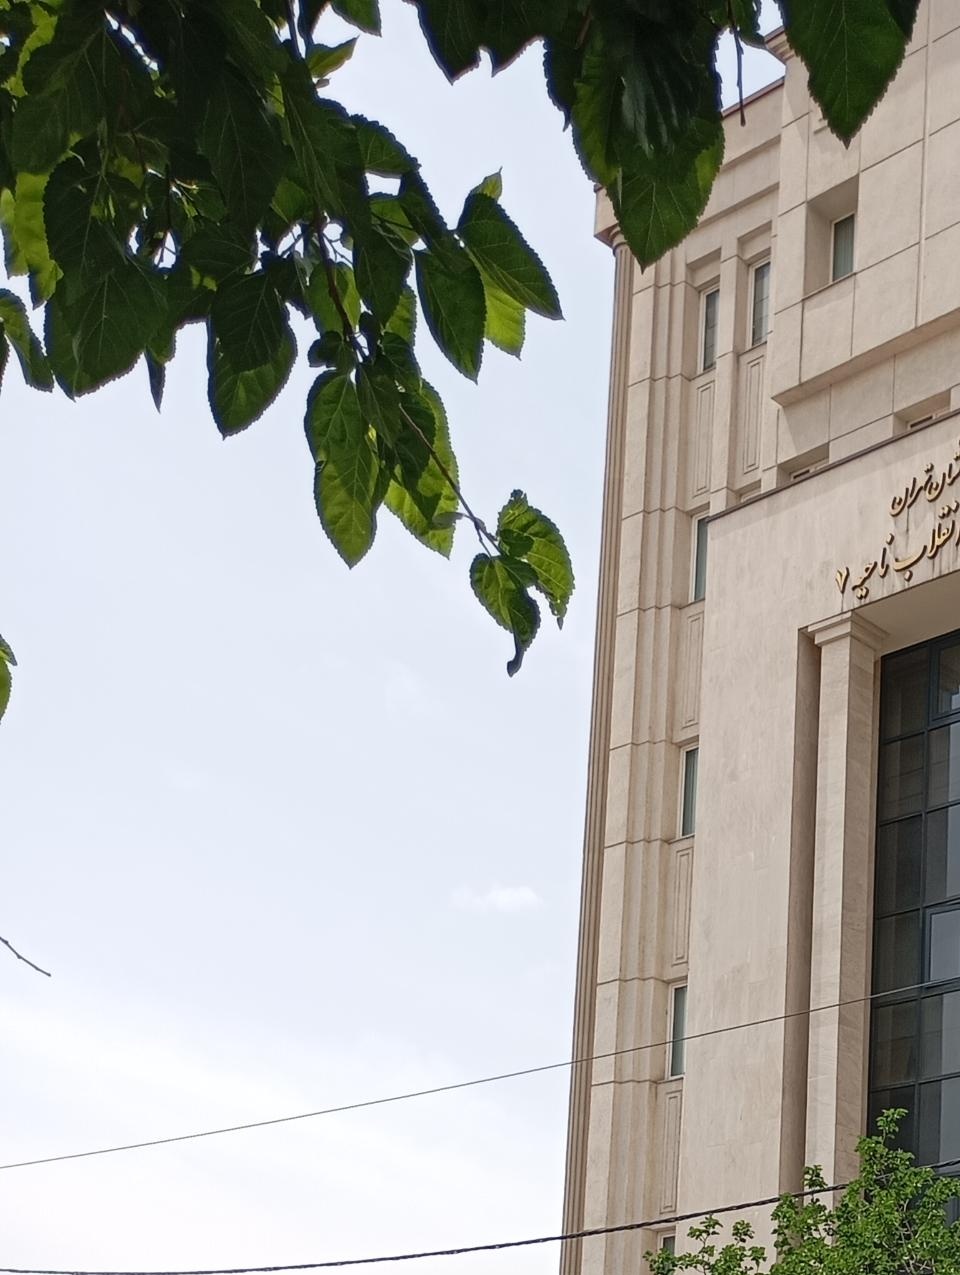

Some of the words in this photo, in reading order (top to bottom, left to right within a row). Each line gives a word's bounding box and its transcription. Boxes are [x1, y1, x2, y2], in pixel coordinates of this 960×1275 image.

[890, 462, 934, 517] تهران
[835, 566, 850, 594] ۷
[851, 533, 895, 600] ناحیه
